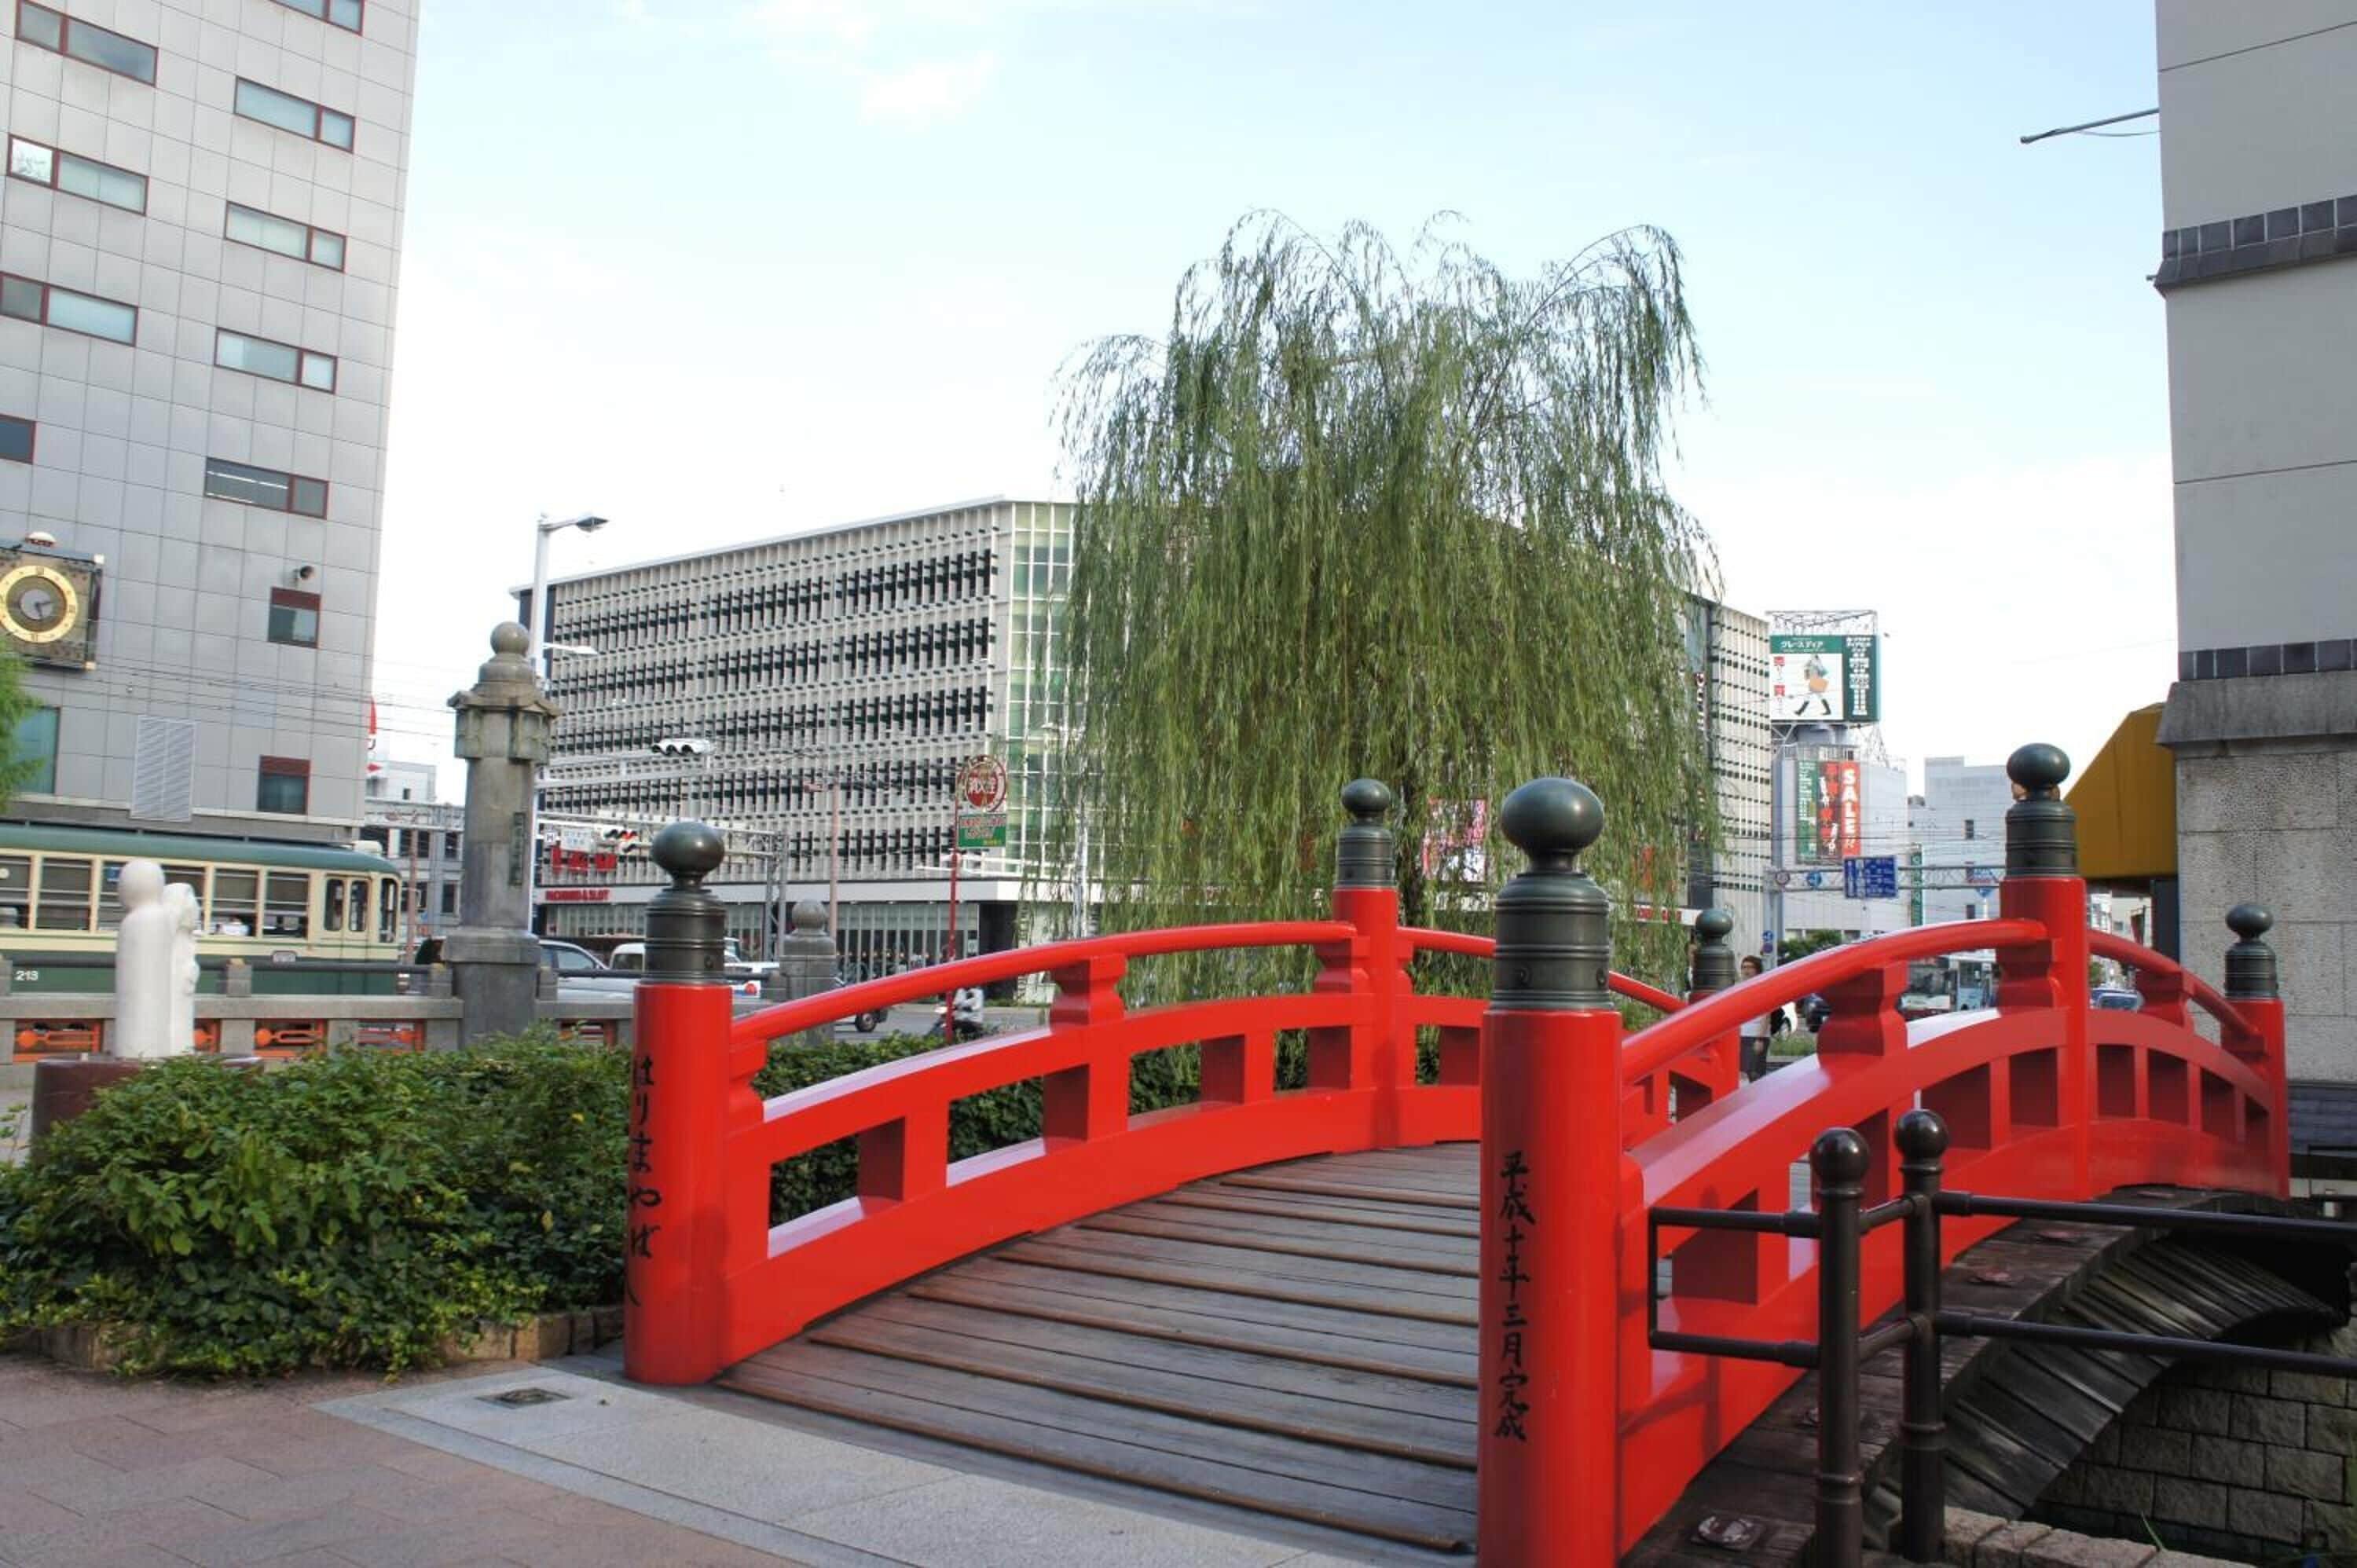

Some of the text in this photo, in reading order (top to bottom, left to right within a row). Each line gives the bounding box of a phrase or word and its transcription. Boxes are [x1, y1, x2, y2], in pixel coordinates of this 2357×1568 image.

[14, 969, 38, 981] 213
[1494, 1150, 1536, 1442] 平成十年三月完成
